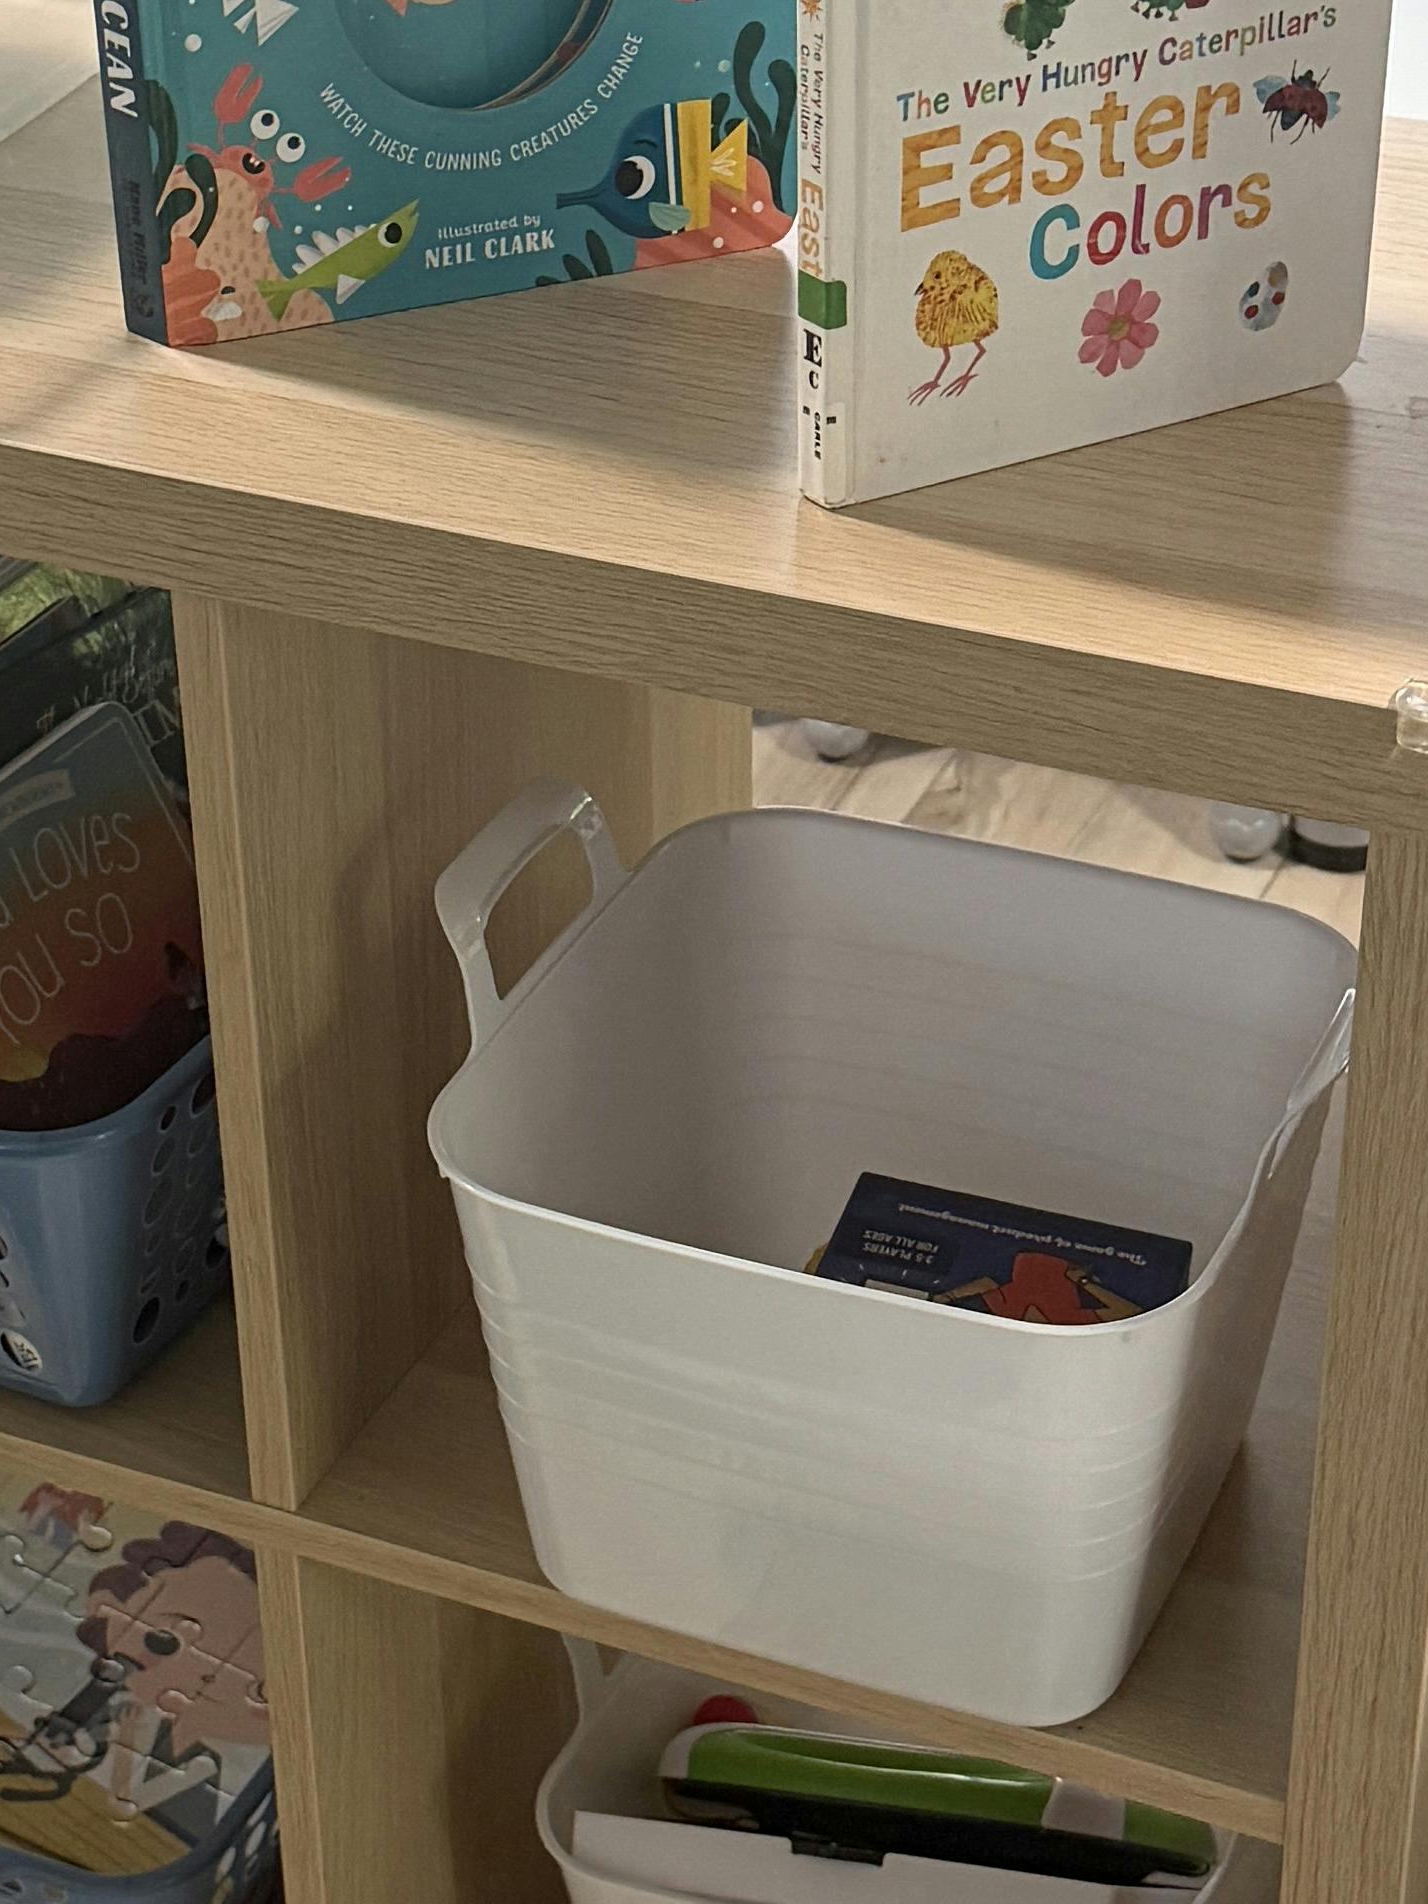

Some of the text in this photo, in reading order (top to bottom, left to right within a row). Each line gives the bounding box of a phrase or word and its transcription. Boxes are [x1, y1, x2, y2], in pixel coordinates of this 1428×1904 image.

[896, 5, 1337, 122] The Very Hungry Caterpillar's
[320, 31, 644, 171] WATCH THESE CUNNING CREATURES CHANGE
[809, 32, 824, 175] The Very Hungry
[900, 80, 1241, 233] Easter
[523, 214, 542, 228] by
[800, 177, 823, 277] East
[1029, 172, 1272, 281] Colors
[424, 228, 556, 269] NEIL CLARK
[803, 328, 823, 368] E
[808, 369, 820, 390] C
[64, 892, 134, 968] SO
[862, 1229, 940, 1255] FOR ALL AGES
[862, 1242, 913, 1262] PLAYERS
[1073, 1242, 1115, 1258] game
[1117, 1249, 1148, 1267] The
